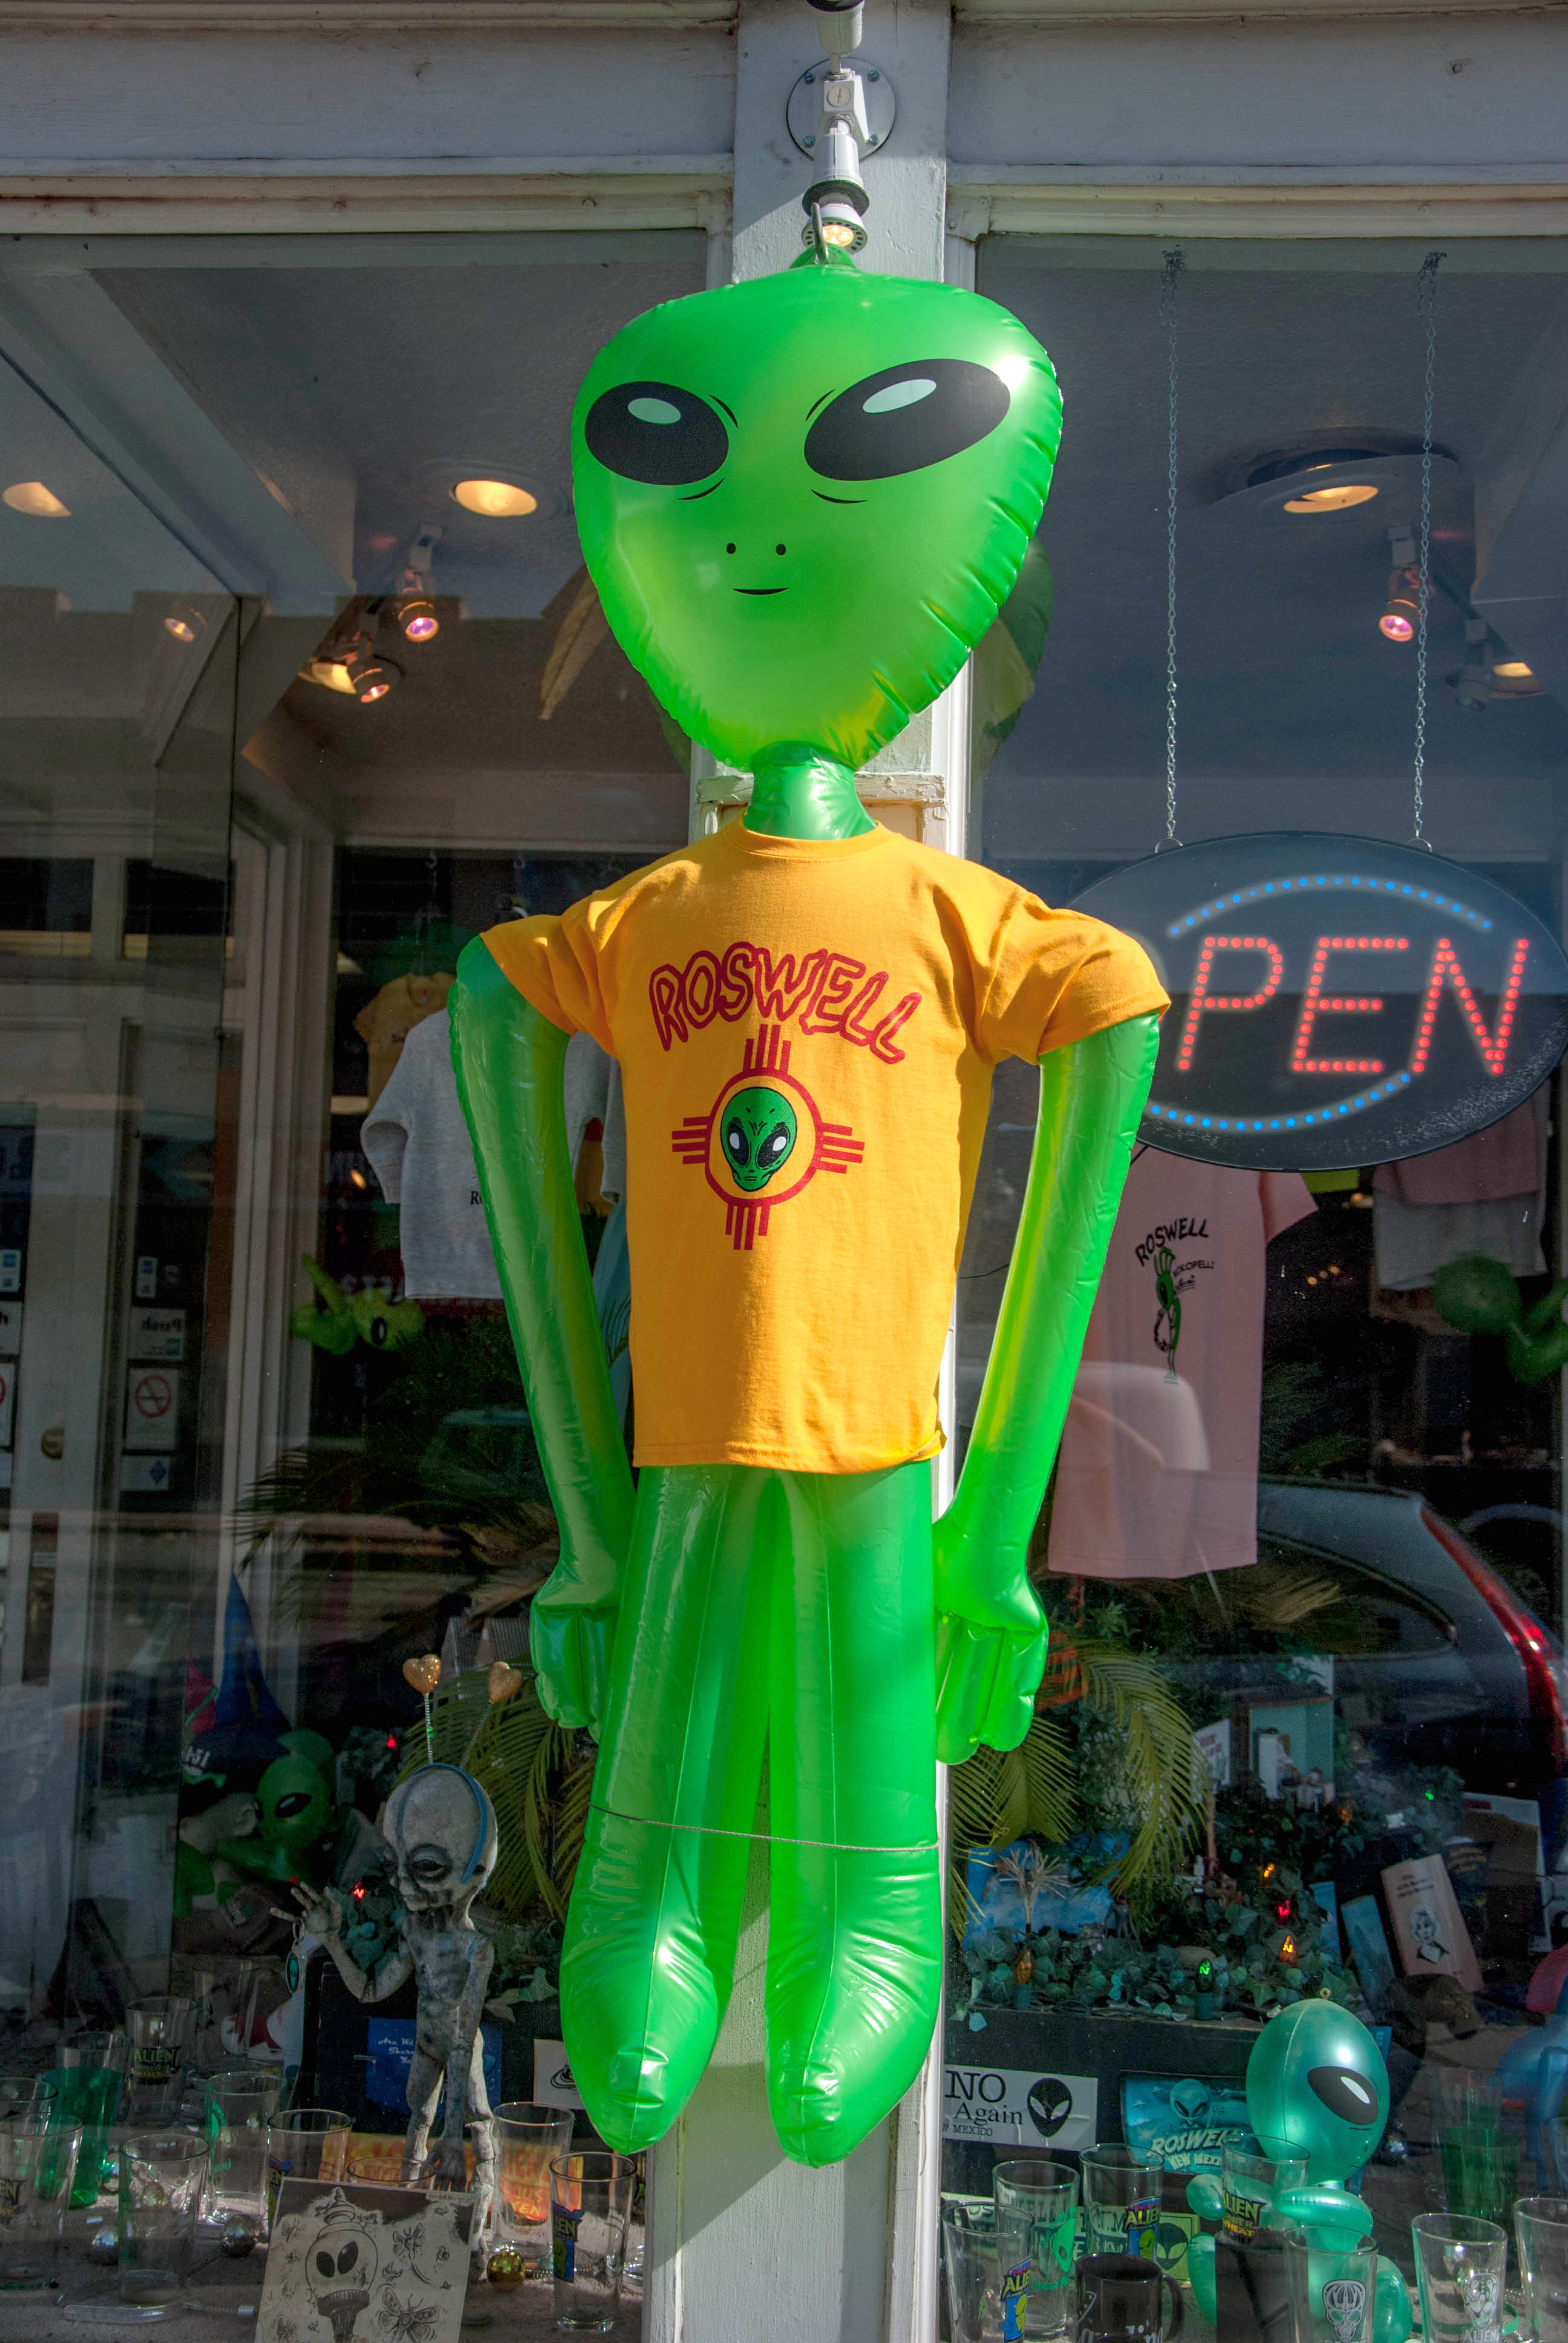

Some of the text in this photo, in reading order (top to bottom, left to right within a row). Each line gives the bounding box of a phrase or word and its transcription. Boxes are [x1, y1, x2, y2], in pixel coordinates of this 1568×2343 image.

[649, 942, 923, 1064] ROSWELL
[1175, 936, 1529, 1075] PEN
[1135, 1217, 1209, 1267] ROSWELL
[944, 2070, 1006, 2103] NO
[953, 2102, 1024, 2126] Again
[953, 2125, 993, 2137] MEXICO
[1168, 2152, 1191, 2170] NEW
[1124, 2206, 1161, 2232] ALIE
[1001, 2269, 1031, 2301] ALIE
